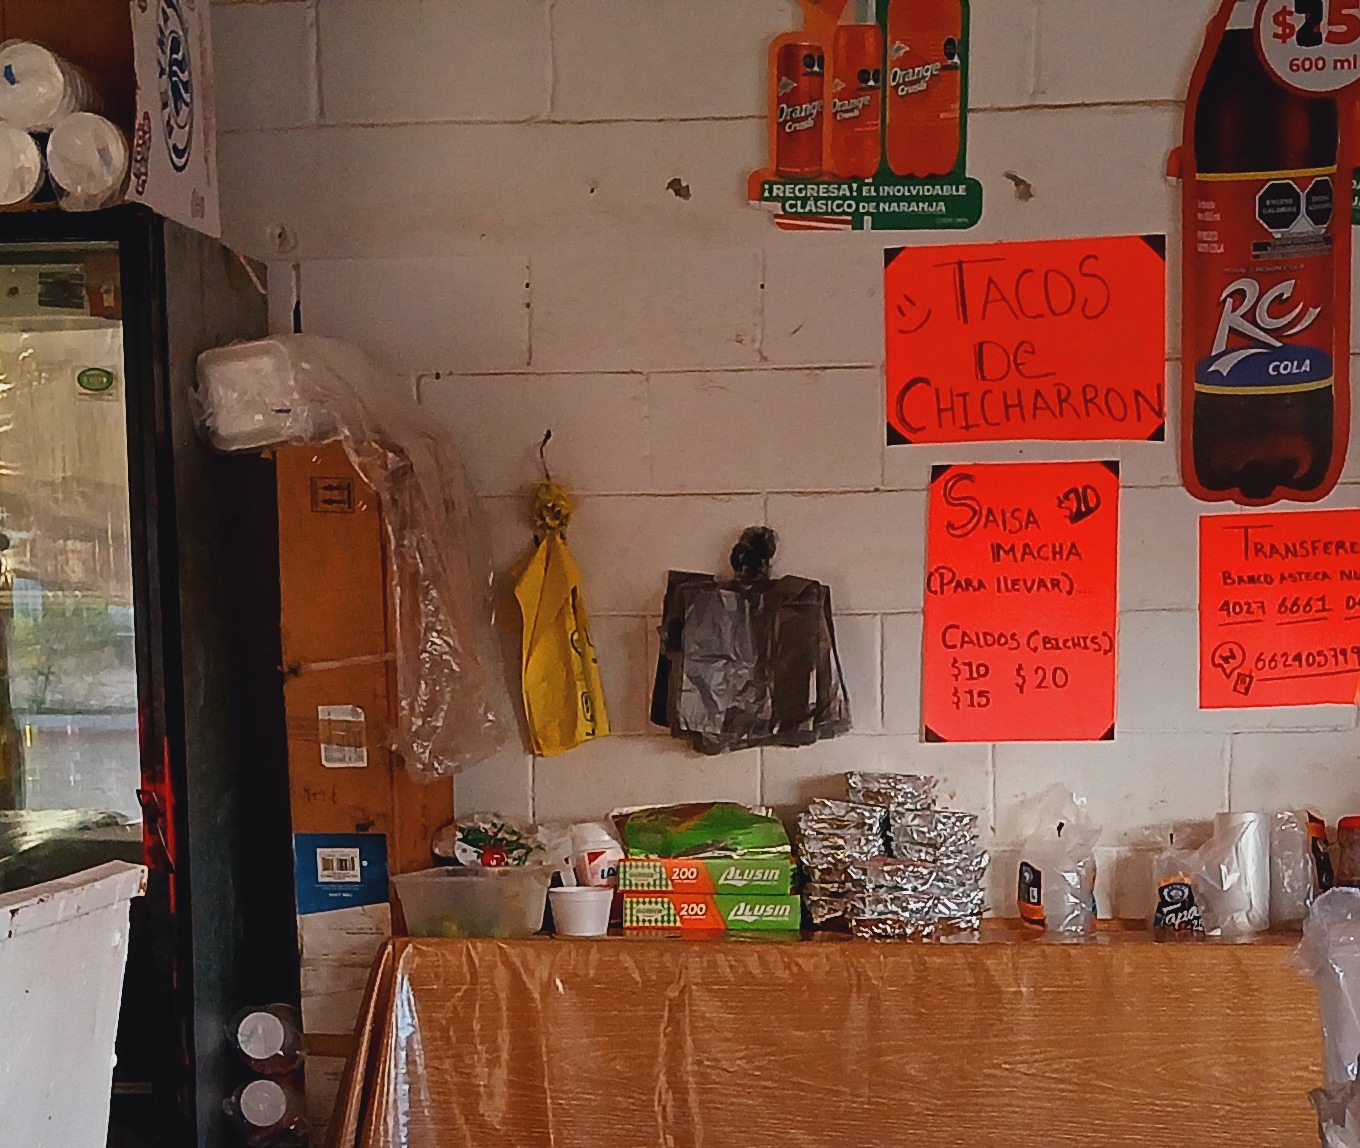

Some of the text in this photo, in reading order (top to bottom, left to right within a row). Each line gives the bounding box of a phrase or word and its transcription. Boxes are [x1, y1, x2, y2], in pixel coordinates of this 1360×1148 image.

[890, 61, 941, 87] Orange
[1289, 55, 1358, 72] 600 ml
[763, 183, 967, 198] ¡REGRESA! EL INOLVIDABLE
[785, 197, 946, 214] CLÁSICO DE NARANJA
[932, 254, 1110, 325] TACOS
[1211, 278, 1304, 356] RC
[973, 340, 1057, 382] DE
[1268, 359, 1310, 376] COLA
[896, 376, 1166, 434] CHICHARRON
[1222, 570, 1274, 586] BANCO
[1218, 600, 1266, 617] 4027
[1277, 595, 1333, 614] 6661
[951, 657, 990, 681] $10
[952, 687, 991, 710] $15
[672, 866, 780, 885] 200 ALUSIN
[680, 902, 791, 922] 200 ALUSIN
